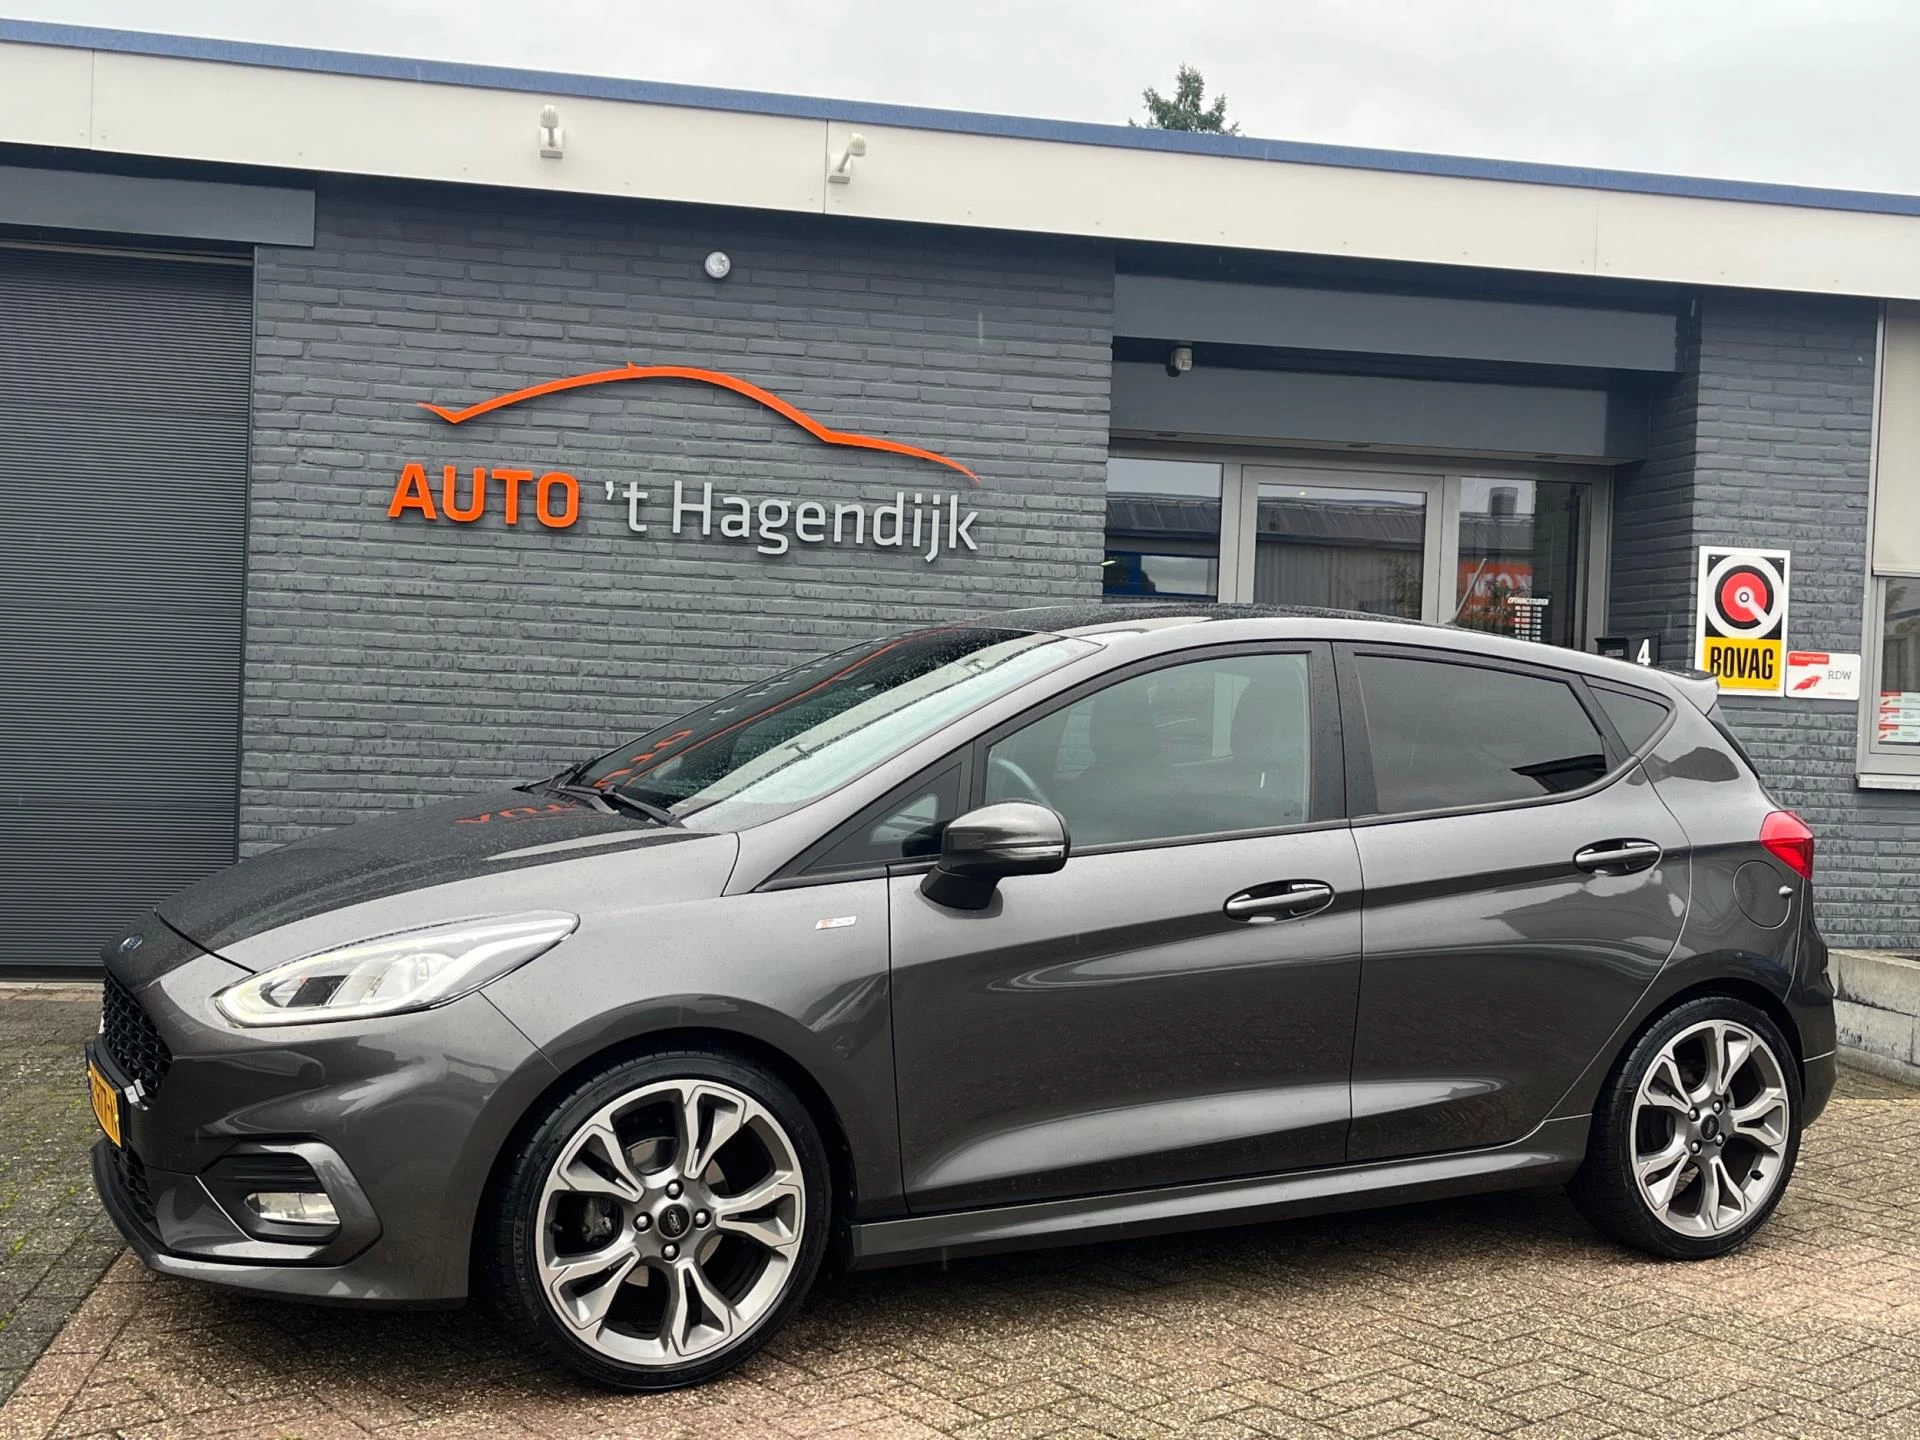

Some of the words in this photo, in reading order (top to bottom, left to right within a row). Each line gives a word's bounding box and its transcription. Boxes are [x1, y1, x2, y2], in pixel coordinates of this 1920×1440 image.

[387, 463, 580, 529] AUTO
[604, 480, 649, 532] 't
[672, 480, 979, 562] Hagendijk
[1636, 638, 1652, 666] 4
[1709, 646, 1772, 680] BOVAG
[1828, 670, 1852, 680] RDW
